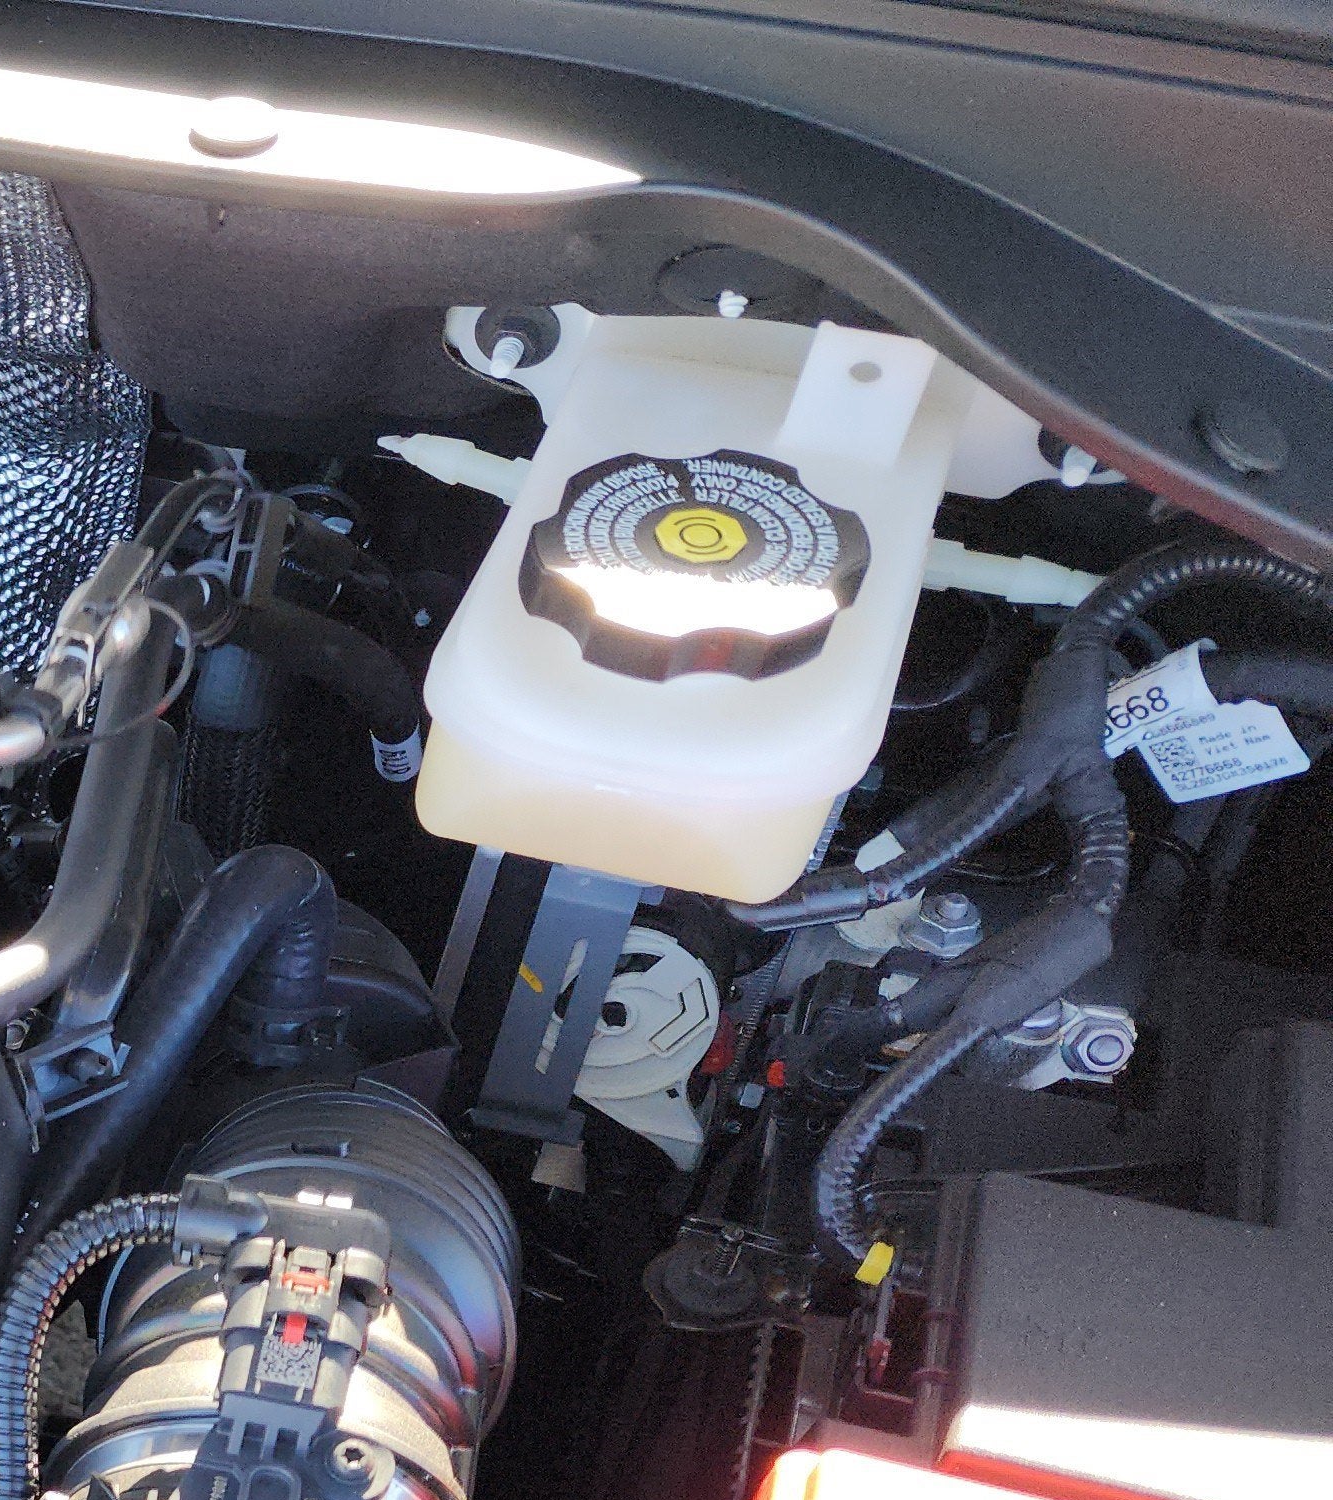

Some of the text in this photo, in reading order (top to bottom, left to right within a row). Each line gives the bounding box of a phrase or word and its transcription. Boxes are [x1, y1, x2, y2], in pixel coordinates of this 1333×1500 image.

[682, 460, 789, 491] CONTAINER.
[690, 474, 737, 491] ONLY
[733, 480, 772, 501] USE
[572, 481, 615, 511] AVANT
[602, 484, 645, 511] FREIN
[694, 487, 760, 511] FILLER
[779, 485, 831, 526] SEALED
[592, 504, 620, 521] DE
[746, 503, 787, 541] CLEAN
[562, 506, 593, 553] BOUCHON
[812, 533, 840, 568] FROM
